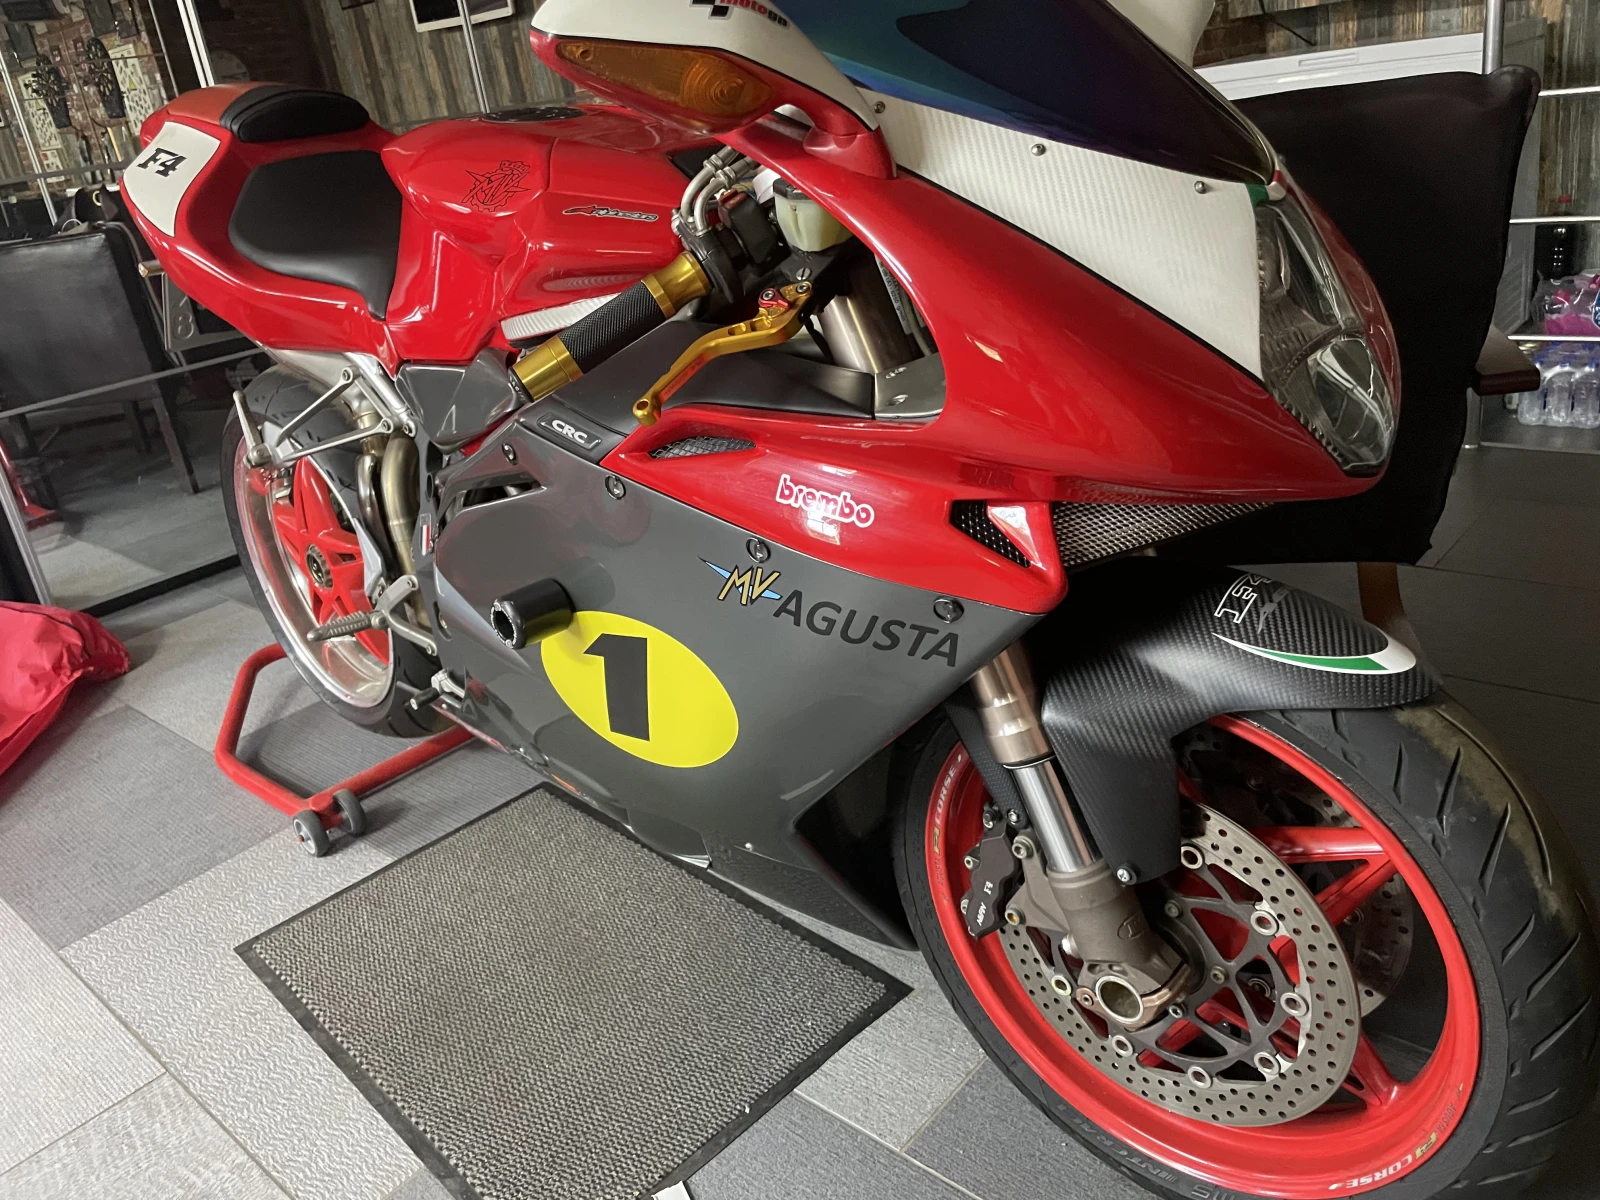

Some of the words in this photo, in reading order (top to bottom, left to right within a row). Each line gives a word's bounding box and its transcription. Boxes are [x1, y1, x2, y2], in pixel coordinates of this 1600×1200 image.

[136, 147, 187, 178] F4
[551, 419, 588, 444] CRC
[775, 473, 875, 528] brembo
[716, 564, 782, 607] MV
[772, 589, 960, 668] AGUSTA
[582, 632, 651, 742] 1
[934, 765, 957, 826] CORSE
[1345, 1153, 1414, 1189] CORSE
